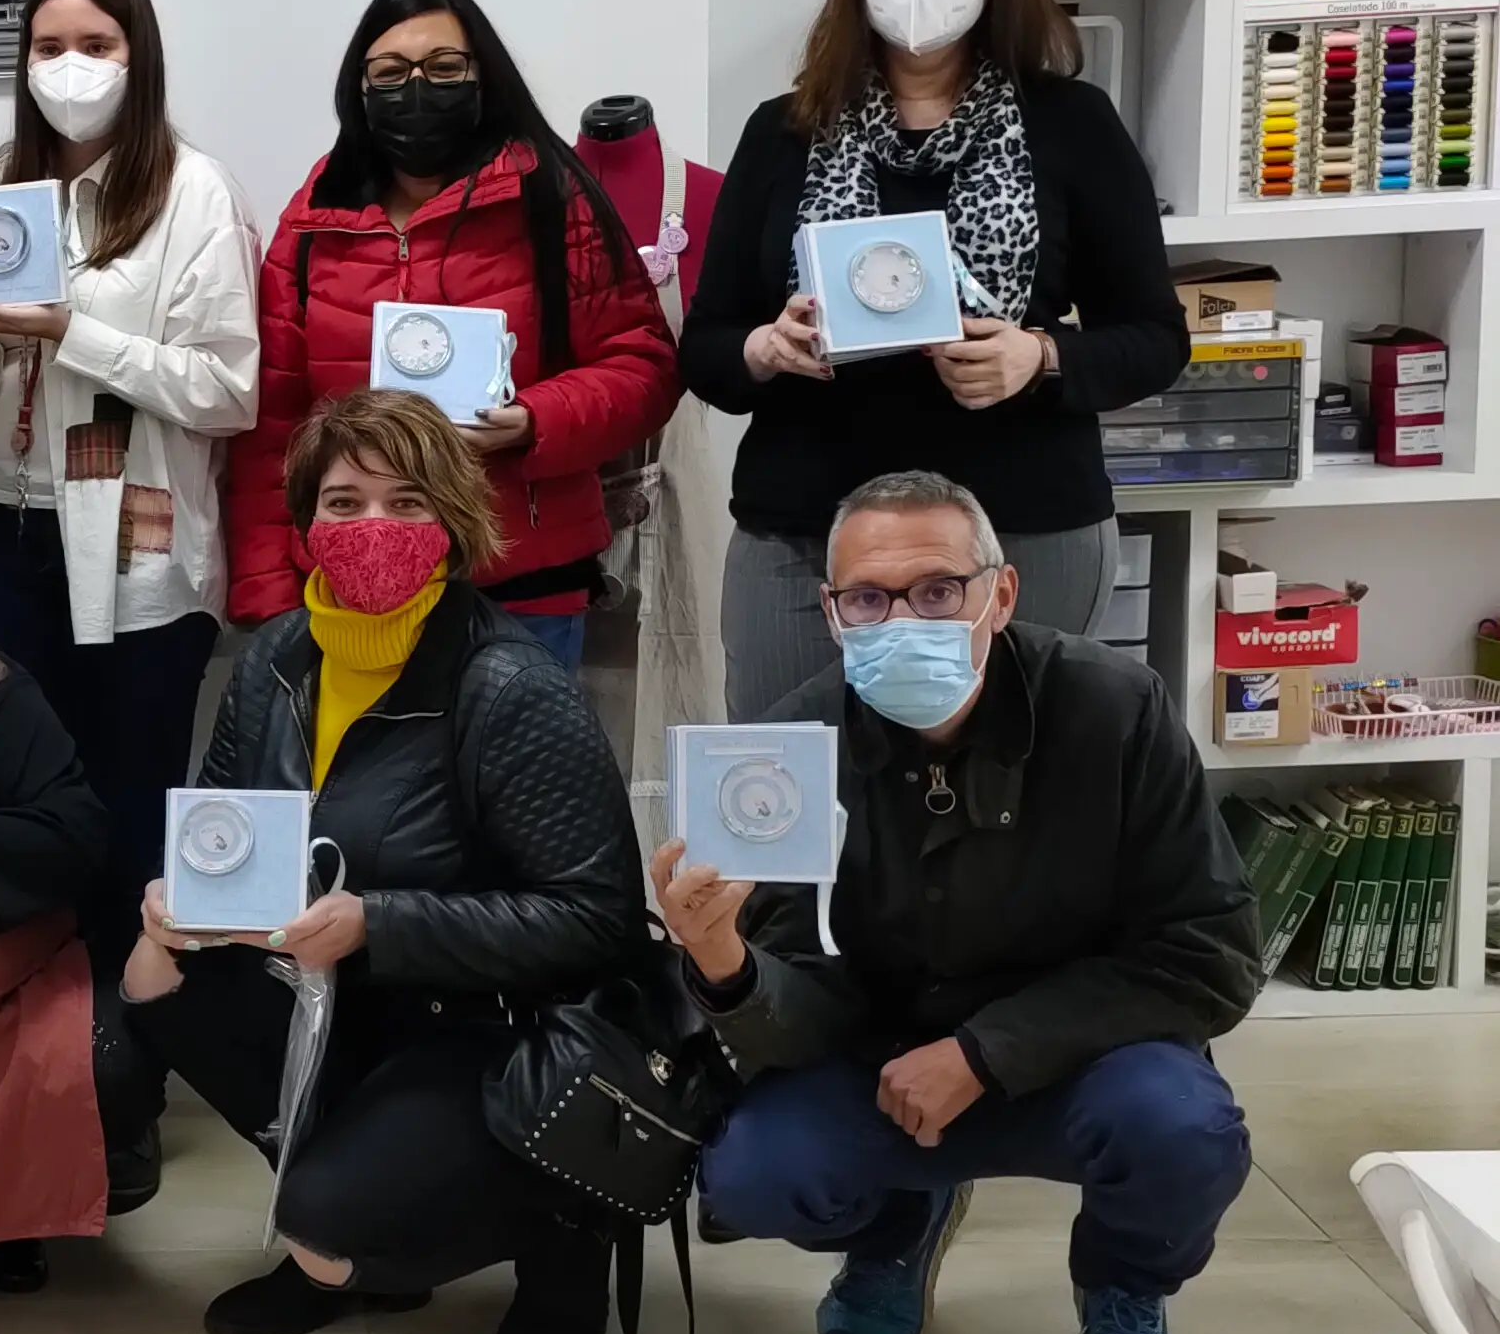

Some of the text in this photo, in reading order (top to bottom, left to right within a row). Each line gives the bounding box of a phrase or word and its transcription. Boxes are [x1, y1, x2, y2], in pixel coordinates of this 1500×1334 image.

[1381, 0, 1398, 11] 100
[1354, 820, 1363, 833] 6
[1377, 820, 1387, 833] 5
[1398, 819, 1408, 833] 3
[1422, 817, 1431, 831] 2
[1446, 817, 1453, 830] 1
[1327, 837, 1340, 850] 7
